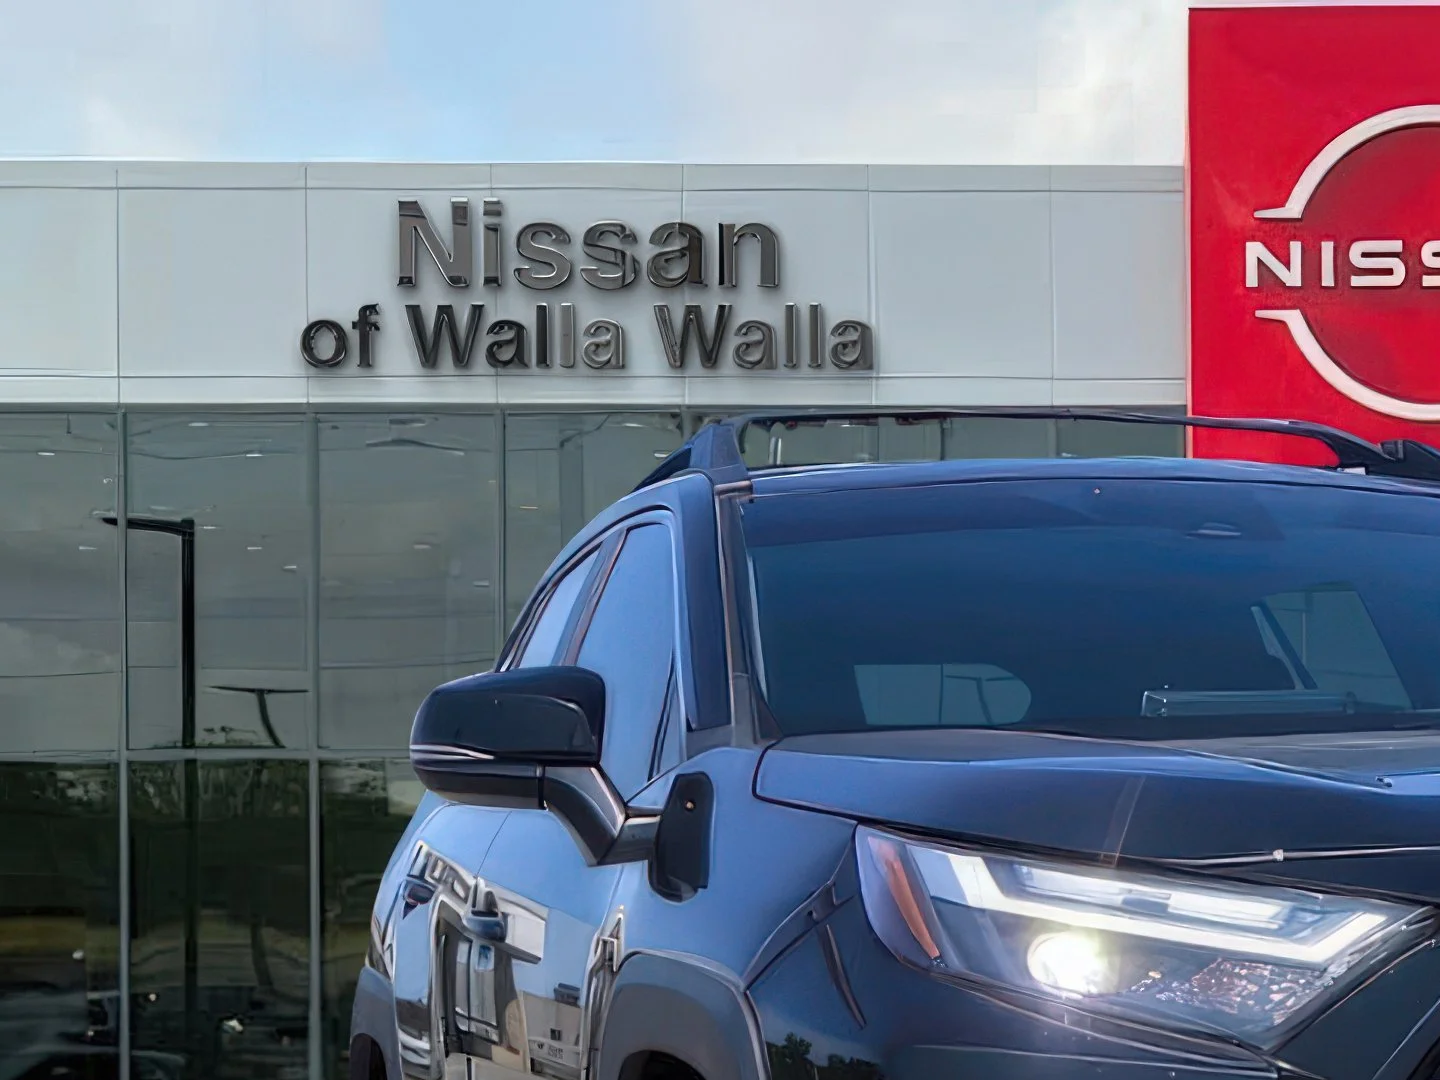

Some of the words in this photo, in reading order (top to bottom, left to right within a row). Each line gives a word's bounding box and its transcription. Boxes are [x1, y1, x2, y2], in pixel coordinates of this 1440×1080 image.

[397, 196, 781, 289] Nissan
[299, 303, 382, 369] of
[404, 303, 627, 369] Walla
[652, 303, 874, 370] Walla
